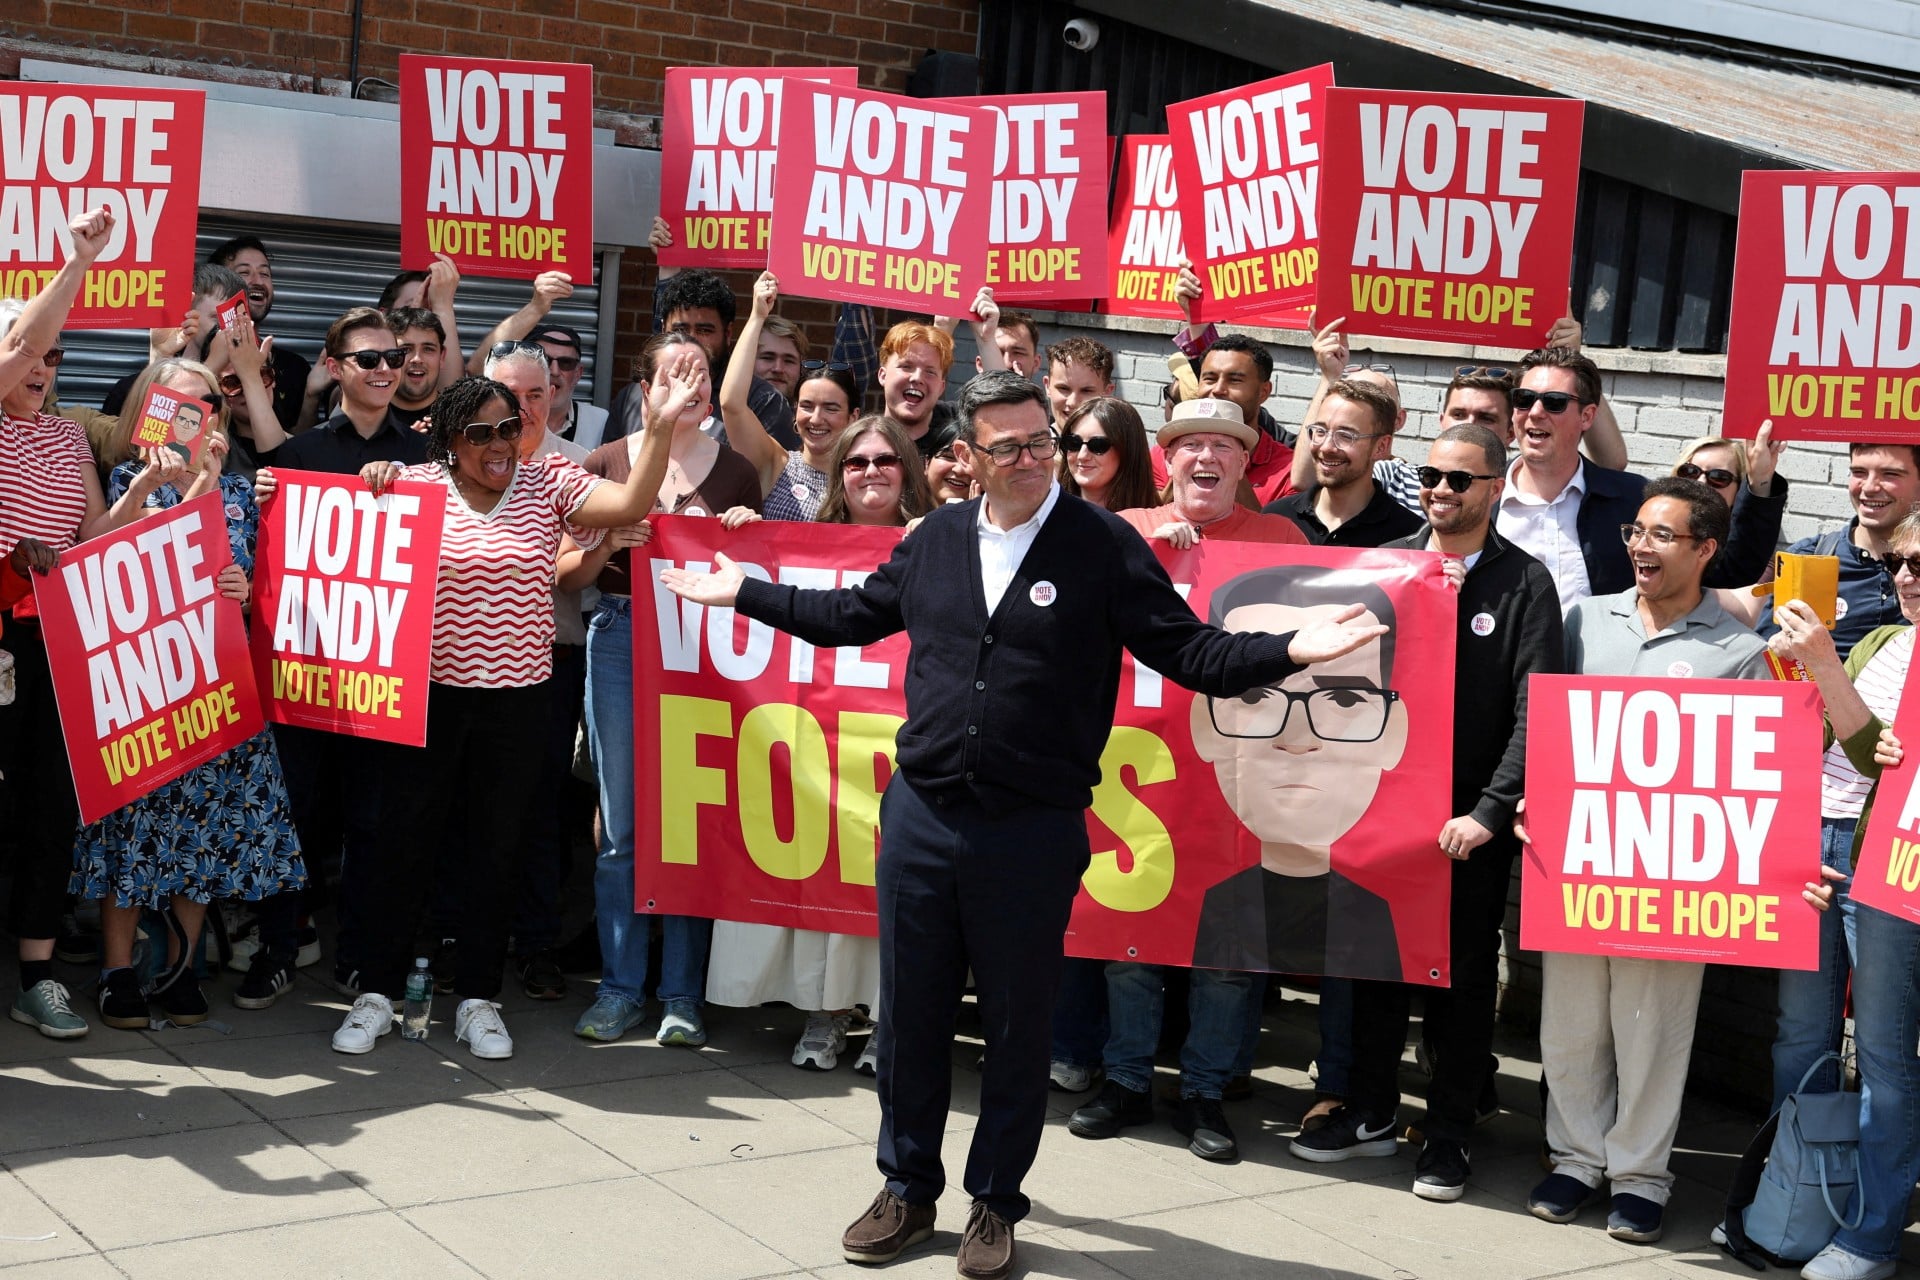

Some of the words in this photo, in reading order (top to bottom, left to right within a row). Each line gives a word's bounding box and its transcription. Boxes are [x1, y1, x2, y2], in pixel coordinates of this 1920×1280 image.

[0, 94, 175, 184] VOTE
[425, 68, 567, 151] VOTE
[690, 77, 830, 147] VOT
[813, 92, 971, 188] VOTE
[980, 103, 1080, 177] TE
[1189, 82, 1319, 186] VOTE
[427, 147, 564, 221] ANDY
[685, 150, 778, 212] AND
[1134, 144, 1178, 208] VO
[1360, 103, 1547, 198] VOTE
[0, 186, 169, 262] ANDY
[427, 218, 492, 258] VOTE
[500, 224, 567, 263] HOPE
[685, 217, 750, 250] VOTE
[803, 170, 964, 257] ANDY
[989, 178, 1078, 244] DY
[1120, 210, 1187, 268] AN
[1204, 165, 1319, 260] ANDY
[1351, 193, 1538, 279] ANDY
[1782, 184, 1920, 280] VOT
[0, 270, 61, 301] VOT
[84, 269, 166, 308] HOPE
[802, 242, 877, 288] VOTE
[884, 256, 962, 299] HOPE
[1008, 248, 1081, 283] HOPE
[1117, 270, 1160, 301] VOTE
[1208, 256, 1268, 301] VOTE
[1271, 246, 1319, 290] HOP
[1351, 273, 1434, 319] VOTE
[1444, 281, 1535, 327] HOPE
[1768, 283, 1920, 369] AND
[143, 416, 170, 435] VOTE
[146, 404, 174, 422] ANDY
[151, 393, 178, 412] VOTE
[1768, 374, 1865, 419] VOTE
[1874, 377, 1920, 421] HO
[139, 428, 167, 446] HOPE
[285, 484, 421, 584] VOTE
[62, 511, 215, 652] VOTE
[1035, 586, 1052, 594] VOTE
[273, 574, 408, 668] ANDY
[649, 558, 890, 689] VOTE
[1476, 617, 1492, 625] VOTE
[87, 601, 221, 740] ANDY
[272, 659, 332, 707] VOTE
[337, 671, 404, 719] HOPE
[100, 718, 171, 786] VOTE
[174, 682, 241, 750] HOPE
[1567, 690, 1783, 792] VOTE
[660, 694, 906, 887] FOR
[1081, 725, 1177, 913] S
[1562, 789, 1779, 886] ANDY
[1885, 837, 1920, 893] VO
[1562, 883, 1662, 933] VOTE
[1673, 891, 1780, 942] HOPE
